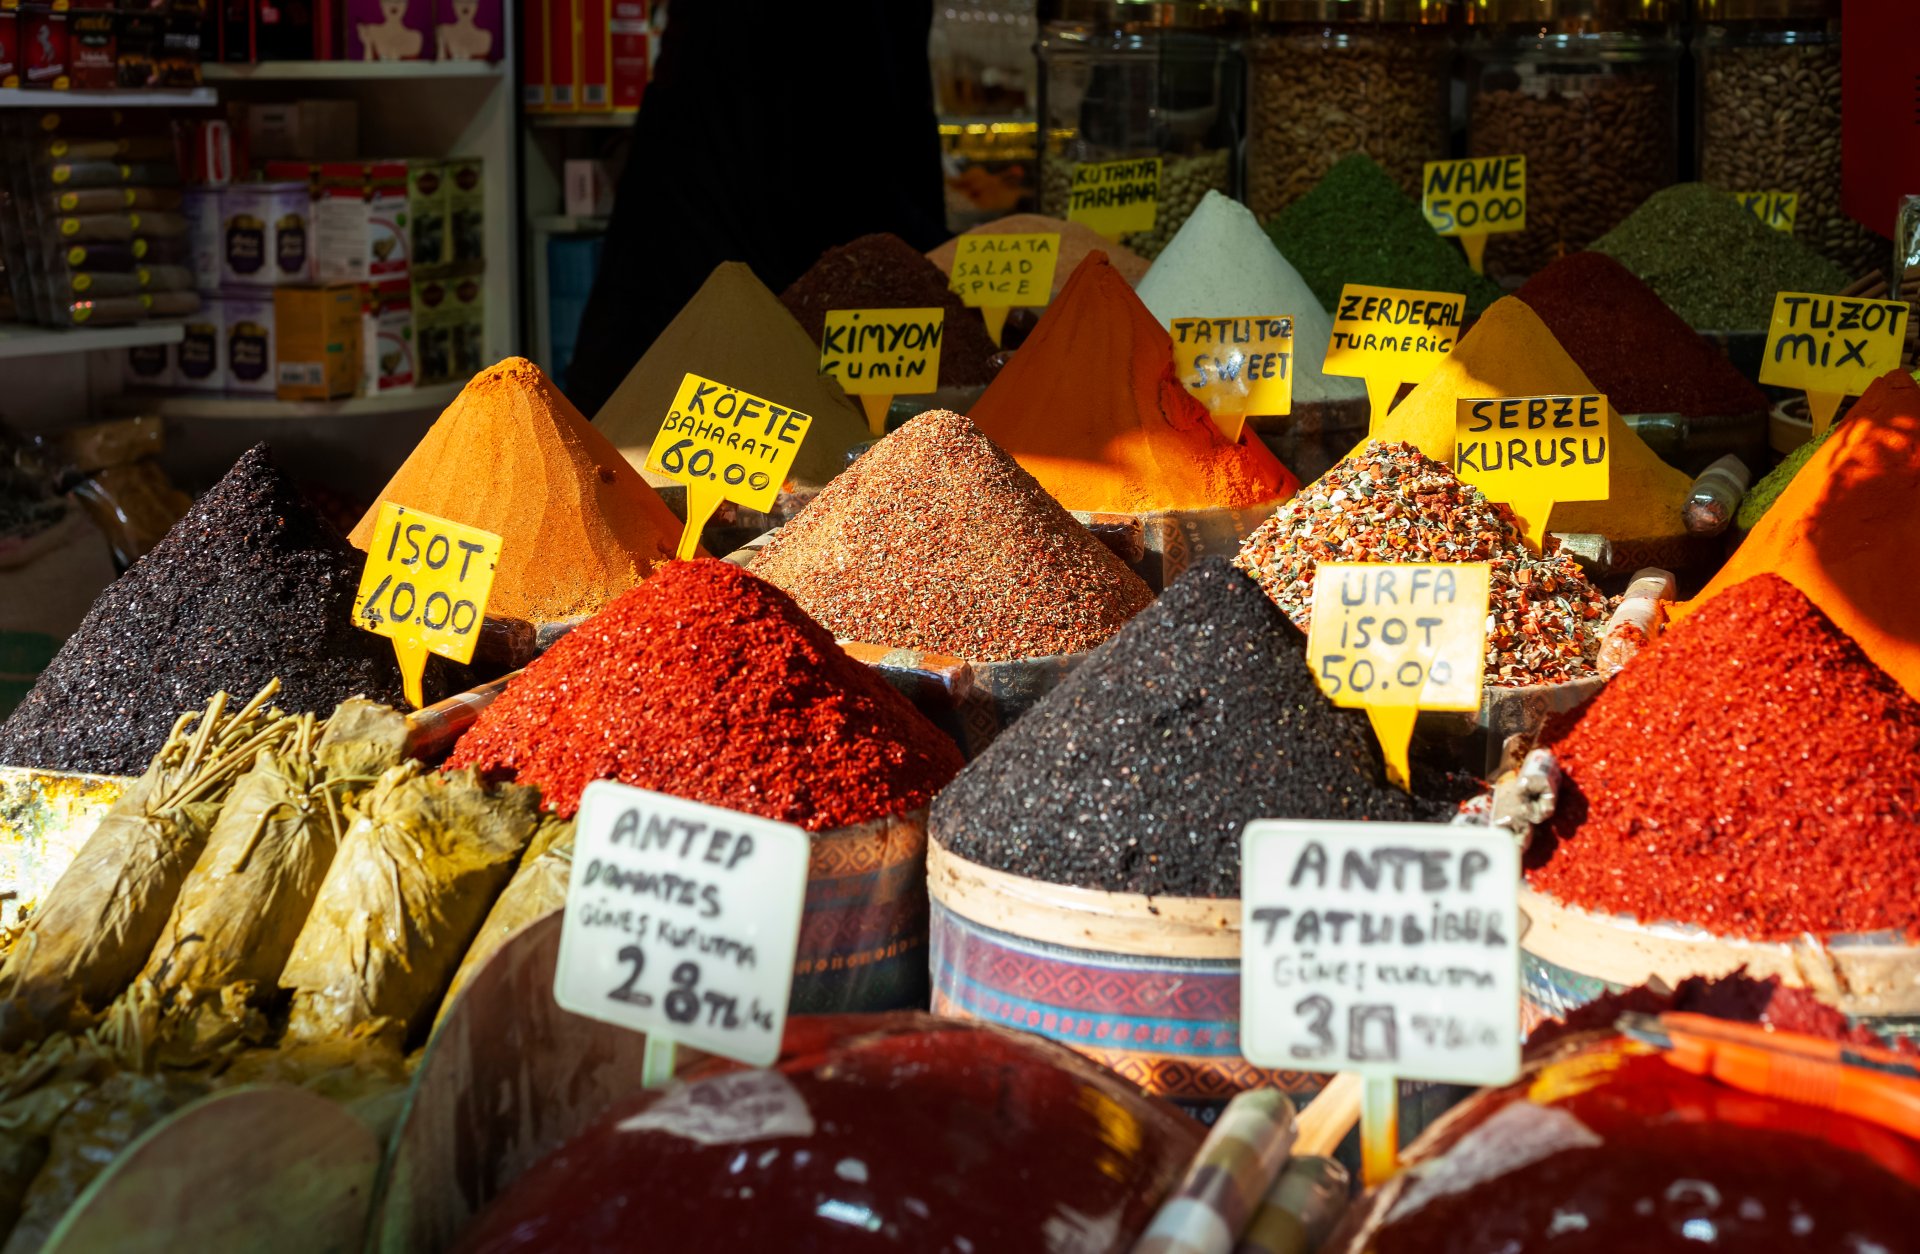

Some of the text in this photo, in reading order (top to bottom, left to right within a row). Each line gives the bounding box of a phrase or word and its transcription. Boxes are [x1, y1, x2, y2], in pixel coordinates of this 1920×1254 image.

[1073, 182, 1157, 209] TARHANA
[1428, 158, 1522, 195] NANE
[967, 239, 1051, 254] SALATA
[956, 280, 1031, 296] SPICE
[958, 259, 1033, 278] SALAD
[1338, 295, 1461, 331] ZERDEÇAL
[1782, 297, 1909, 337] TUZOT
[1191, 352, 1291, 389] SWEET
[687, 381, 808, 444] KÖFTE
[1468, 396, 1601, 432] SEBZE
[662, 410, 780, 464] BAHARATI
[1456, 436, 1606, 475] KURUSU
[660, 438, 770, 491] 60.00
[1321, 654, 1453, 695] 50.00
[609, 807, 757, 871] ANTEP
[1288, 840, 1492, 892] ANTEP
[1289, 994, 1400, 1063] 30
